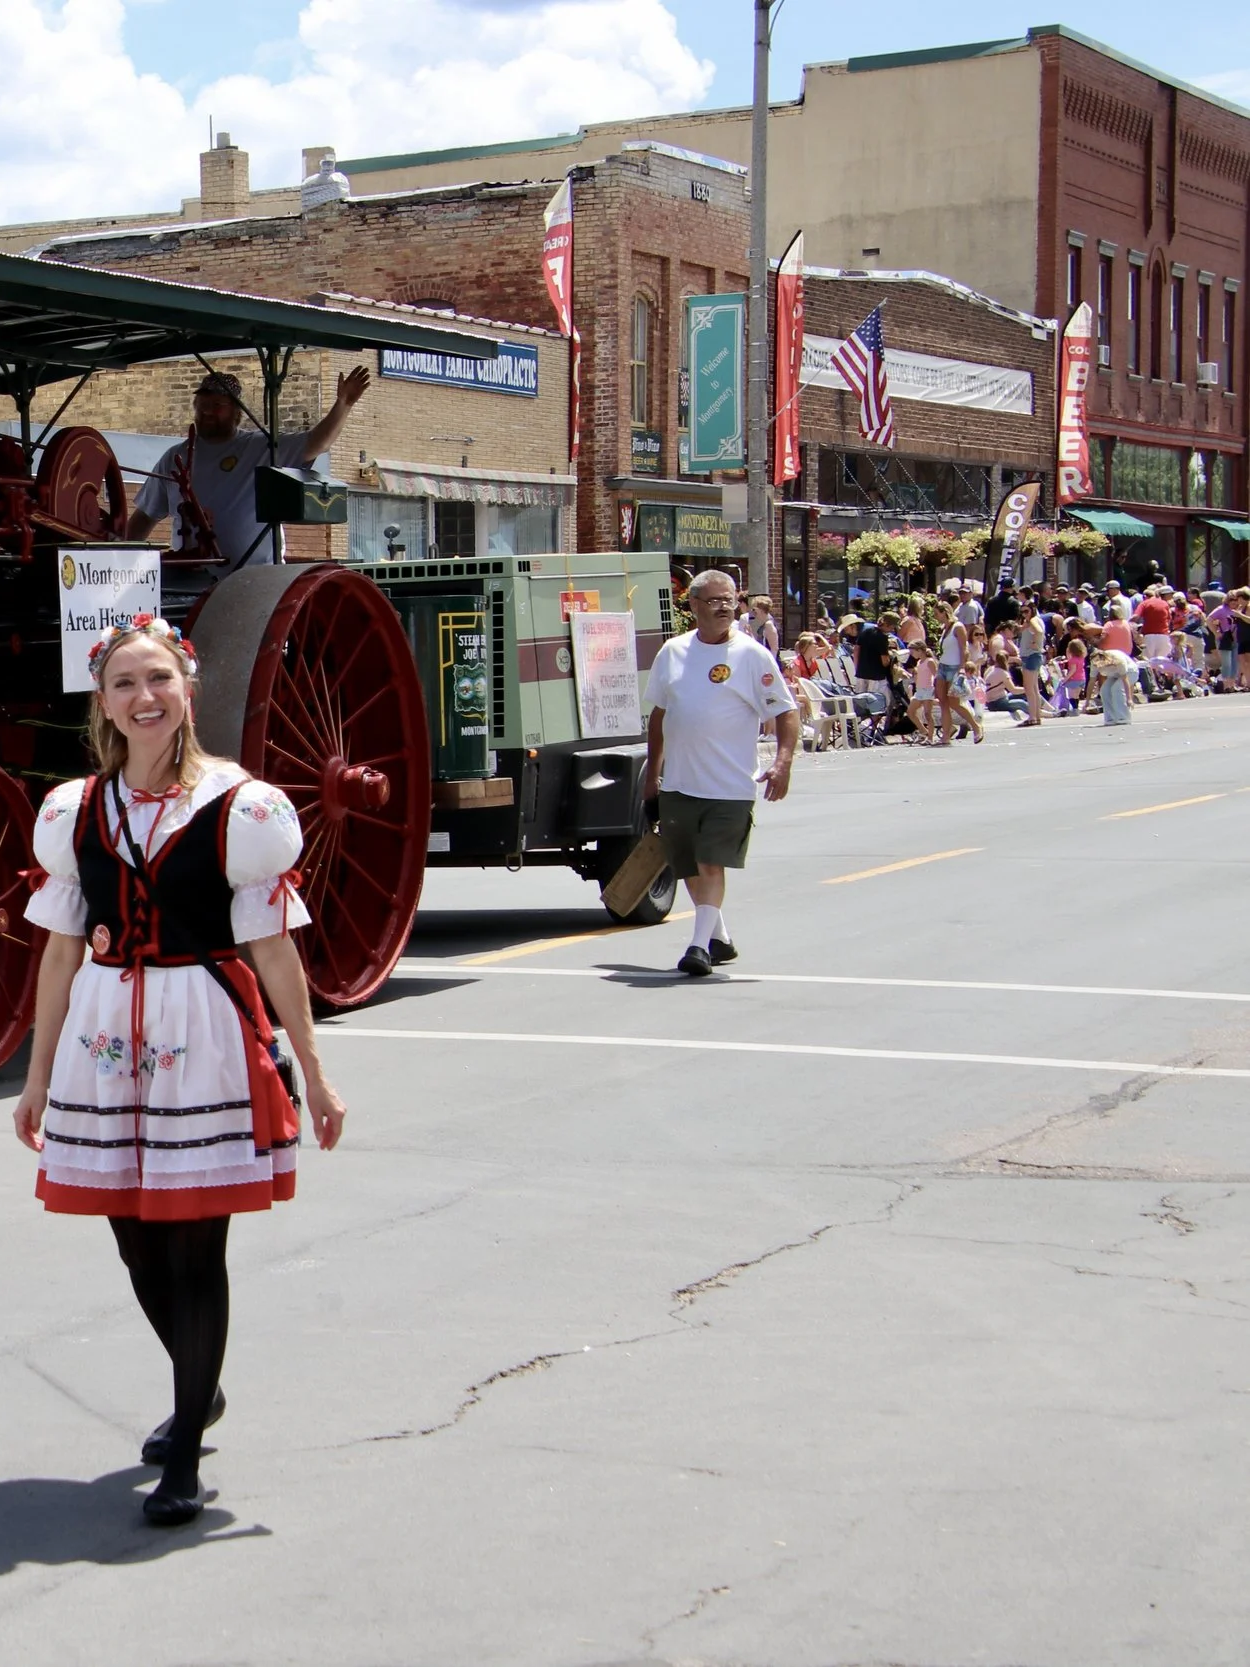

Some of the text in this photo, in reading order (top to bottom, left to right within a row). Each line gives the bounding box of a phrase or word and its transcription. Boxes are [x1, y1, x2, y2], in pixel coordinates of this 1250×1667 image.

[693, 181, 710, 202] 1880
[700, 346, 730, 377] Welcome
[1068, 345, 1091, 355] COL
[710, 380, 720, 390] to
[697, 386, 734, 426] Montgomery
[1058, 360, 1089, 496] BEER
[78, 562, 158, 592] Montgomery
[66, 608, 96, 632] Area
